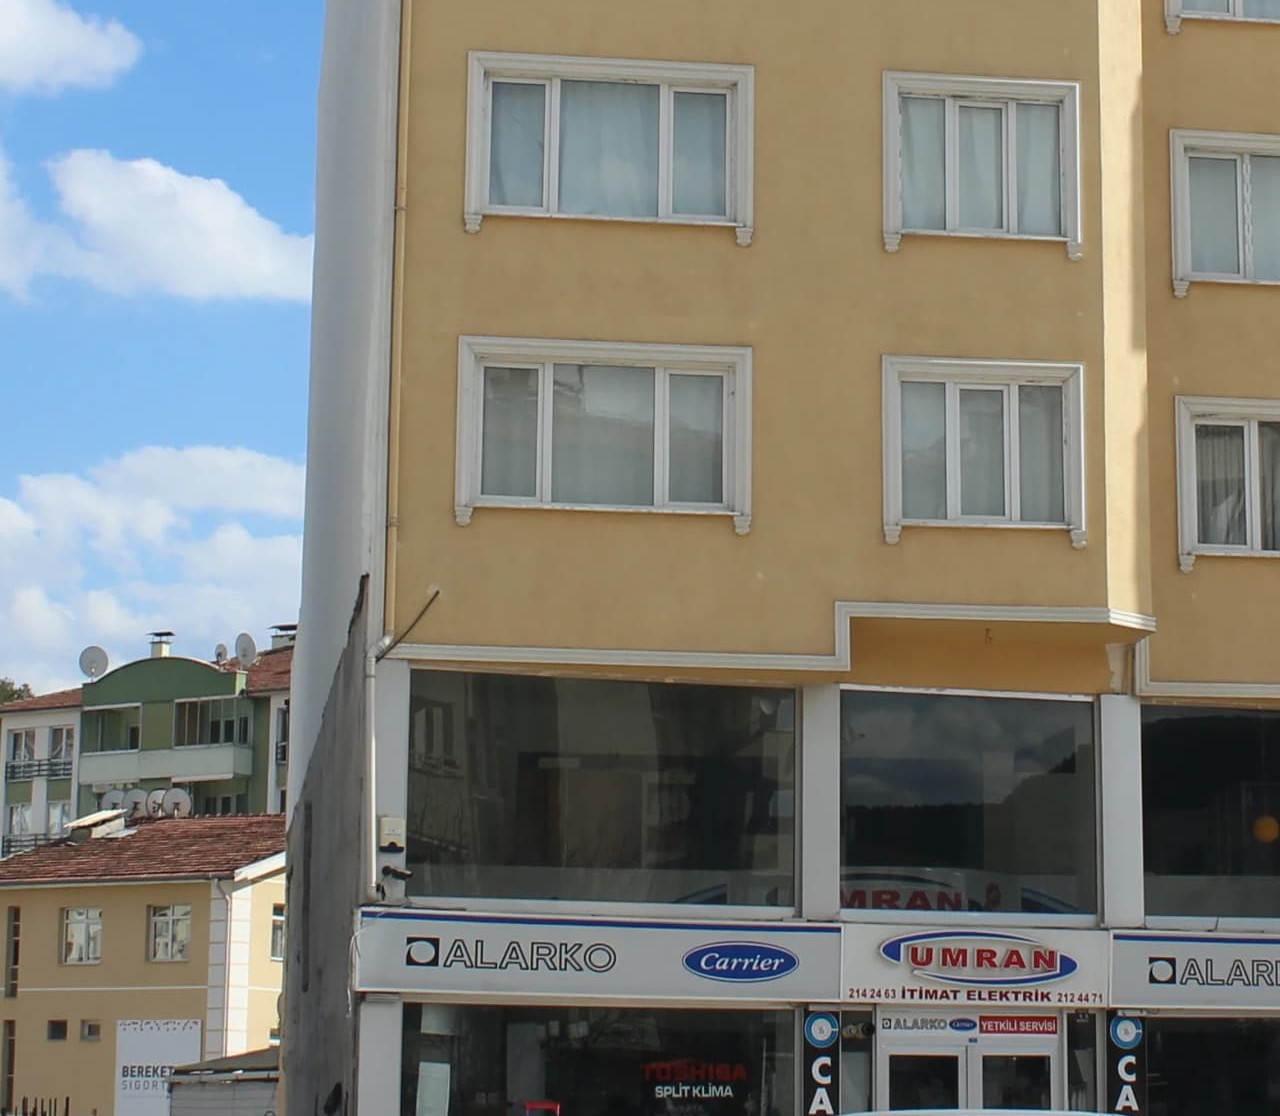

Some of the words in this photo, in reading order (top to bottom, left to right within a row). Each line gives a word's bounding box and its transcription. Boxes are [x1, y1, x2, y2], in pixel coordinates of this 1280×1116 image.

[840, 889, 963, 910] MRAN
[443, 938, 617, 973] ALARKO
[699, 951, 785, 973] Carrier
[910, 946, 1058, 970] UMRAN
[848, 988, 867, 999] 214
[870, 988, 883, 999] 24
[884, 989, 896, 999] 63
[901, 985, 961, 1001] İTİMAT
[966, 987, 1052, 1003] ELEKTRİK
[1057, 992, 1076, 1003] 212
[1077, 993, 1090, 1003] 44
[1091, 993, 1103, 1003] 71
[893, 1018, 948, 1031] ALARKO
[981, 1017, 1018, 1032] YETKİLİ
[1019, 1018, 1056, 1033] SERVİSİ
[121, 1065, 175, 1078] BEREKET
[640, 1062, 748, 1082] TOSHIBA
[121, 1079, 167, 1091] SIGORT
[655, 1082, 690, 1099] SPLİT
[692, 1082, 734, 1099] KLİMA
